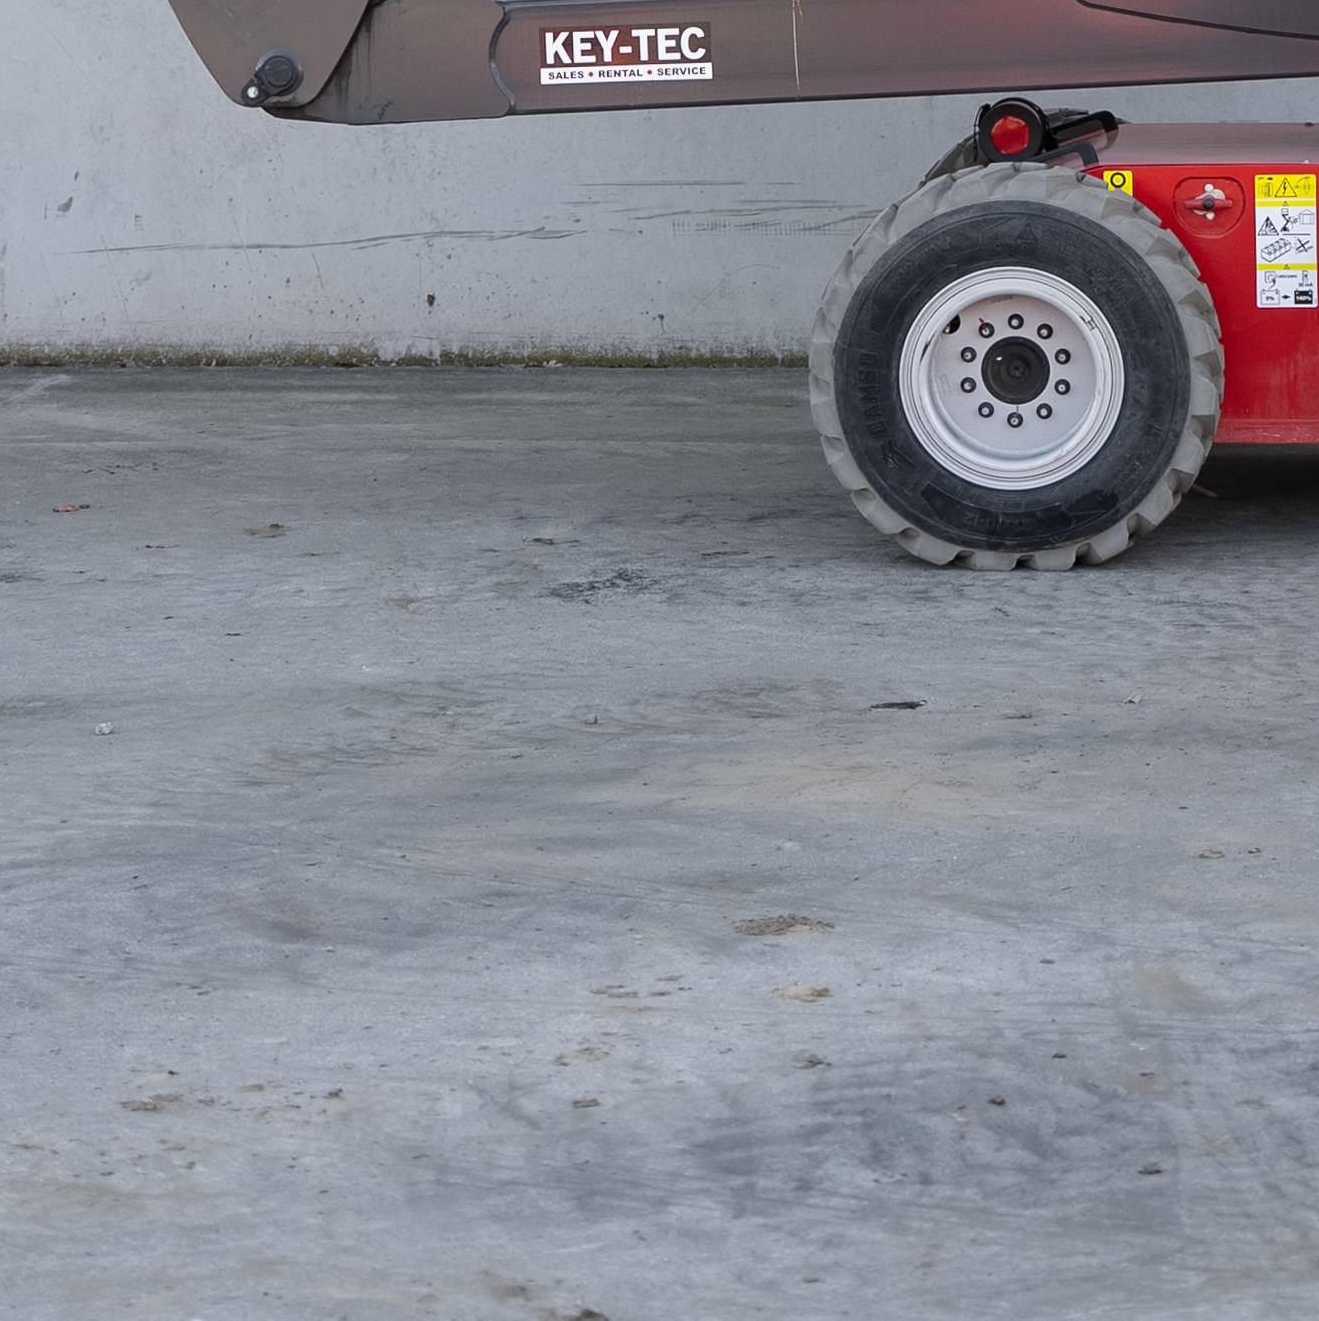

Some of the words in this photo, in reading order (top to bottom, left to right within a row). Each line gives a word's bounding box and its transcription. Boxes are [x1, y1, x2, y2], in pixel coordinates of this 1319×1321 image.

[544, 26, 707, 65] KEY-TEC
[548, 70, 585, 80] SALES
[598, 69, 643, 78] RENTAL
[657, 66, 707, 76] SERVICE
